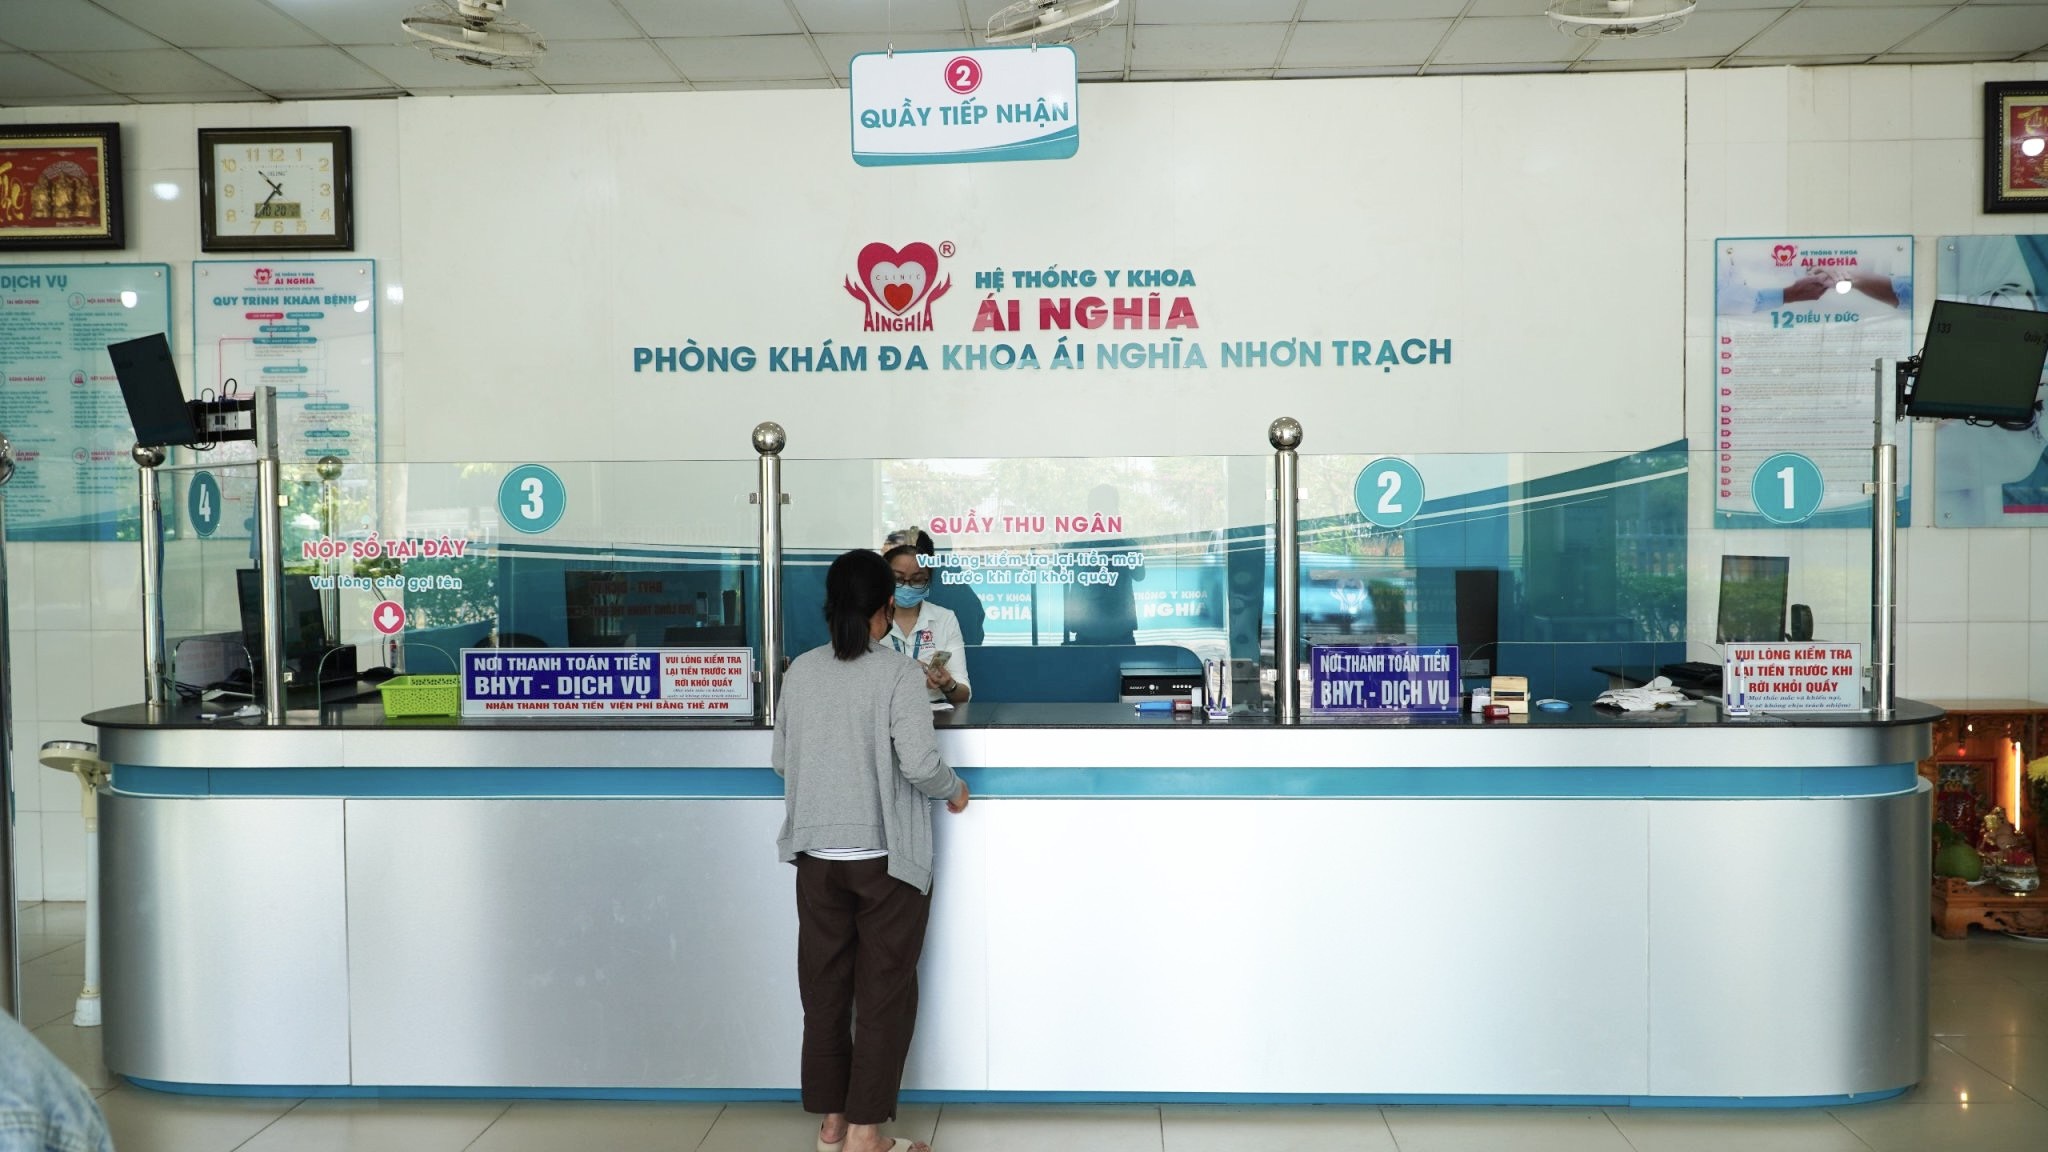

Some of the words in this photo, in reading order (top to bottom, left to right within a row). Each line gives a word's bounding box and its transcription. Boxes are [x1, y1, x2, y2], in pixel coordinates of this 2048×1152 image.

[956, 65, 971, 87] 2
[860, 97, 932, 129] QUẦY
[939, 97, 988, 126] TIẾP
[996, 97, 1069, 128] NHẬN
[0, 275, 41, 292] DỊCH
[46, 275, 68, 292] VỤ
[875, 273, 921, 281] CLINIC
[975, 267, 1005, 293] HỆ
[1012, 264, 1097, 289] THỐNG
[1104, 270, 1121, 288] Y
[1127, 269, 1196, 288] KHOA
[213, 296, 238, 306] QUY
[242, 294, 279, 306] TRÌNH
[284, 294, 319, 305] KHÁM
[324, 294, 357, 307] BỆNH
[972, 293, 1021, 332] ÁI
[1040, 292, 1200, 331] NGHĨA
[1771, 311, 1794, 328] 12
[1824, 314, 1831, 323] Y
[1834, 311, 1860, 323] ĐỨC
[633, 338, 757, 373] PHÒNG
[769, 338, 868, 372] KHÁM
[878, 345, 929, 372] ĐA
[942, 343, 1041, 371] KHOA
[1050, 335, 1085, 370] ÁI
[1097, 337, 1208, 370] NGHĨA
[1221, 337, 1322, 368] NHƠN
[1332, 338, 1452, 373] TRẠCH
[1377, 470, 1403, 514] 2
[1776, 466, 1795, 510] 1
[199, 484, 211, 522] 4
[520, 477, 544, 520] 3
[930, 509, 994, 534] QUẦY
[1003, 516, 1045, 533] THU
[1055, 512, 1122, 533] NGÂN
[304, 537, 347, 563] NỘP
[352, 532, 381, 558] SỔ
[386, 540, 417, 561] TẠI
[424, 536, 466, 556] ĐÂY
[917, 553, 941, 567] Vui
[946, 553, 979, 568] lòng
[985, 550, 1022, 566] kiểm
[1025, 554, 1048, 566] tra
[1054, 554, 1073, 568] lại
[1077, 550, 1108, 565] tiền
[1113, 553, 1144, 569] mặt
[310, 576, 333, 589] Vui
[340, 576, 372, 590] lòng
[376, 576, 405, 588] chờ
[408, 576, 433, 592] gọi
[438, 576, 462, 588] tên
[942, 570, 983, 584] trước
[988, 570, 1012, 583] khi
[1016, 570, 1036, 583] rời
[1042, 567, 1074, 583] khỏi
[1078, 569, 1118, 585] quầy
[985, 603, 1032, 620] GHĨA
[474, 656, 503, 671] NƠI
[507, 657, 562, 671] THANH
[566, 654, 610, 671] TOÁN
[666, 656, 679, 664] VUI
[727, 656, 742, 664] TRA
[1320, 654, 1342, 673] NƠI
[1345, 654, 1385, 673] THANH
[1388, 651, 1420, 672] TOÁN
[1734, 650, 1755, 660] VUI
[1758, 648, 1791, 660] LÒNG
[1830, 650, 1853, 660] TRA
[1788, 664, 1828, 676] TRƯỚC
[1832, 666, 1853, 676] KHI
[475, 676, 534, 695] BHYT
[558, 676, 613, 699] DỊCH
[621, 676, 651, 699] VỤ
[1321, 680, 1365, 706] BHYT
[1382, 680, 1424, 710] DỊCH
[1428, 680, 1450, 710] VỤ
[1773, 679, 1802, 693] KHỎI
[486, 701, 514, 711] NHẬN
[517, 702, 550, 710] THANH
[553, 701, 579, 710] TOÁN
[610, 701, 633, 711] VIỆN
[636, 701, 653, 710] PHÍ
[708, 702, 729, 710] ATM
